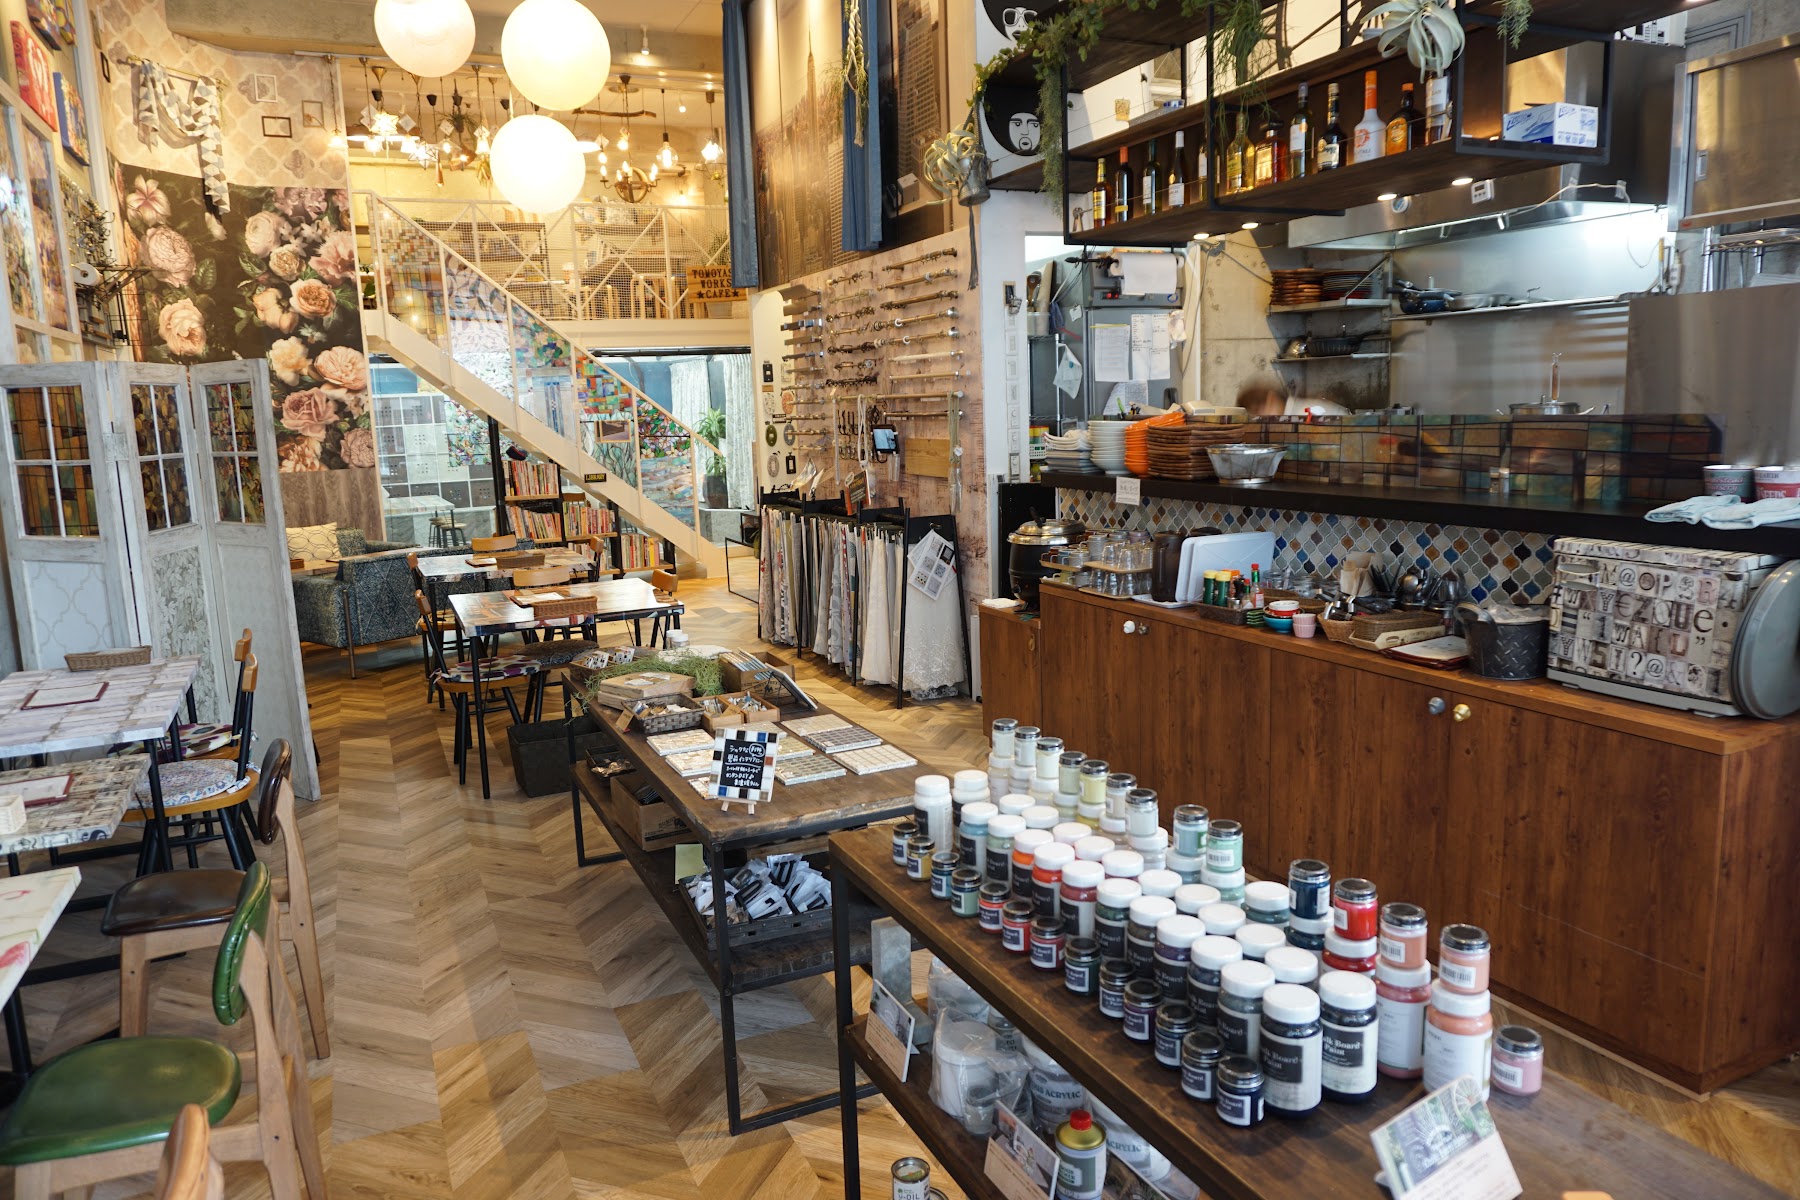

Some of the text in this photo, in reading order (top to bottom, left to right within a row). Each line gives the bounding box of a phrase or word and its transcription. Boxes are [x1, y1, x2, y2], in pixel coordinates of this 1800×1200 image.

[701, 278, 731, 288] WORKS
[706, 288, 731, 298] CAFE
[1324, 1043, 1346, 1056] Paint
[1334, 1040, 1361, 1051] Board
[1264, 1055, 1283, 1069] Paint
[1272, 1050, 1299, 1064] Board
[1045, 1088, 1081, 1099] ACRYLIC
[1106, 1138, 1142, 1152] ACRYLIC
